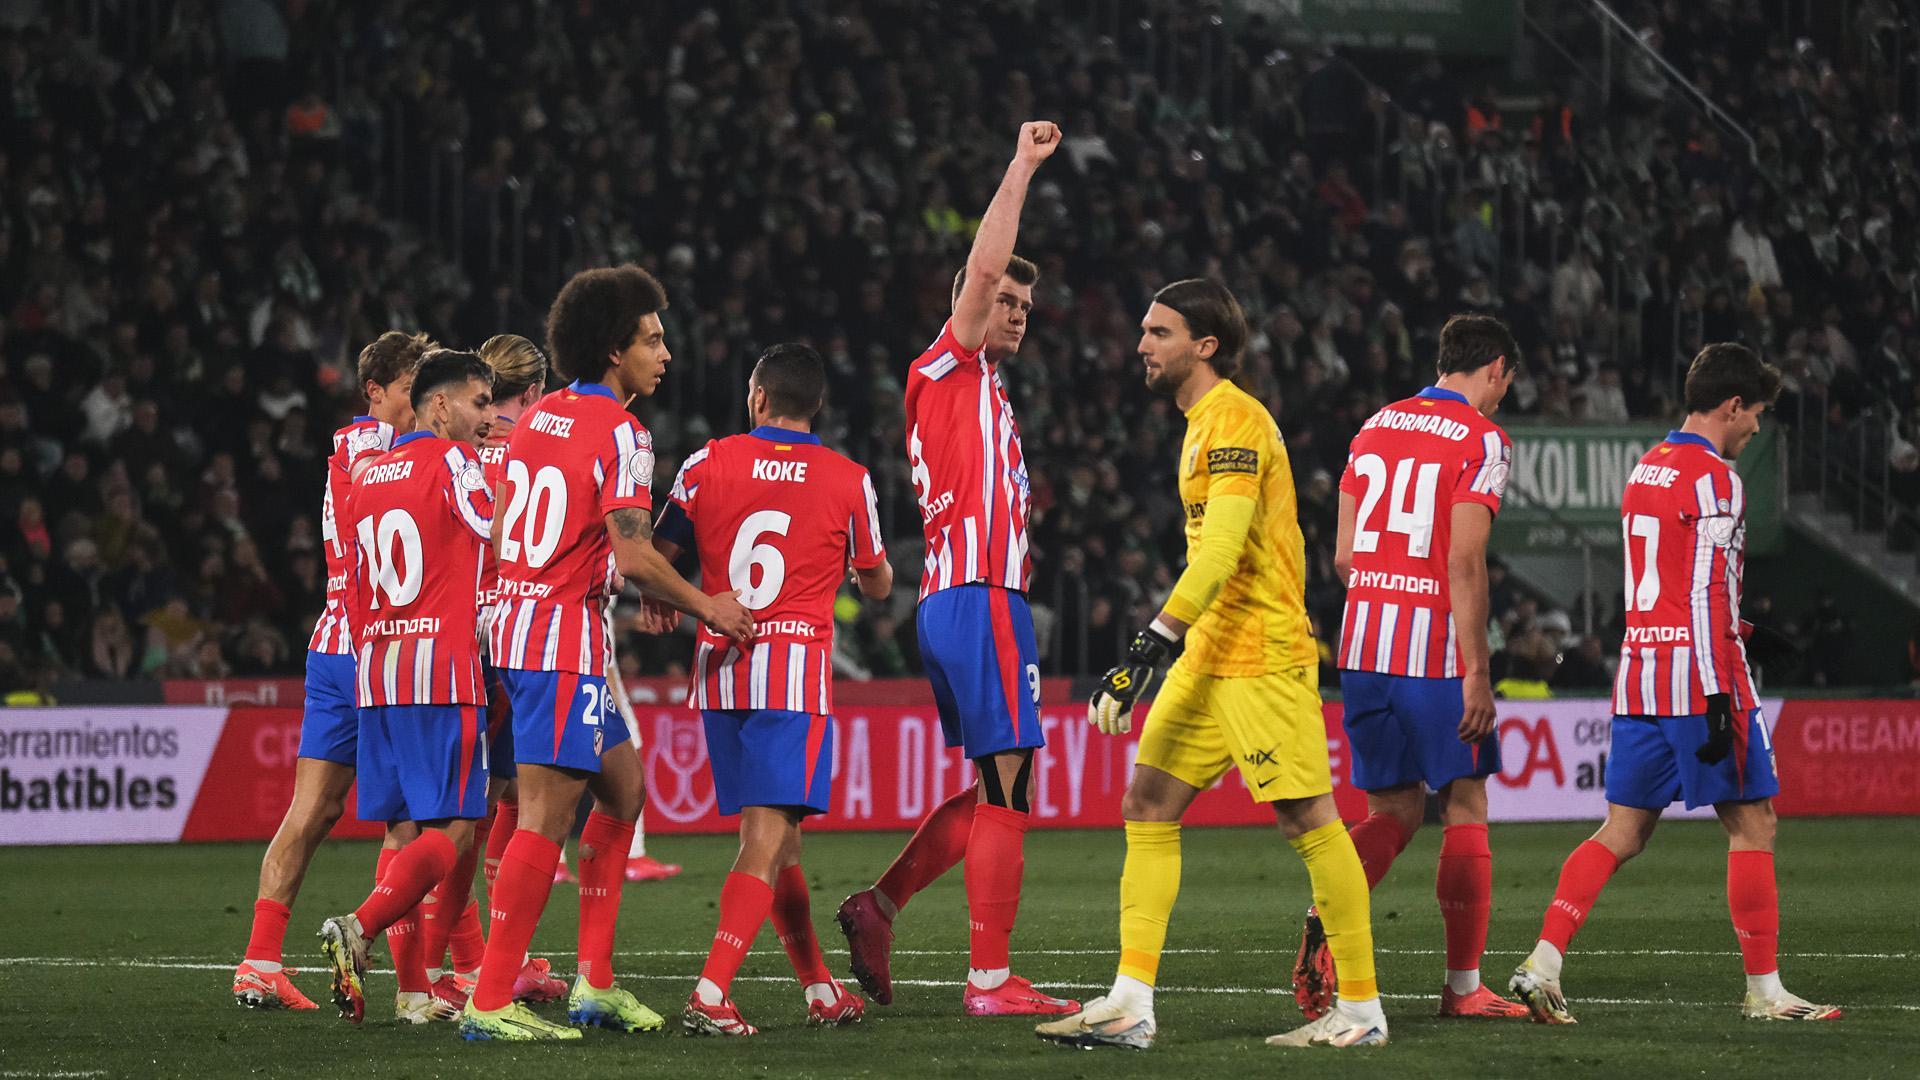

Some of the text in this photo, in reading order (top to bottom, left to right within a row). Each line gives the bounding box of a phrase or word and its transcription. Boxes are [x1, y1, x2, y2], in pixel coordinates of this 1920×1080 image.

[529, 410, 575, 439] WITSEL
[1377, 409, 1470, 442] NORMAND
[362, 460, 414, 487] CORREA
[752, 458, 808, 483] KOKE
[500, 459, 568, 569] 20
[1353, 453, 1442, 559] 24
[355, 508, 424, 611] 10
[728, 509, 792, 611] 6
[1622, 511, 1661, 612] 17
[1360, 570, 1440, 596] HYUNDAI
[1026, 663, 1040, 703] 9
[0, 767, 178, 811] batibles
